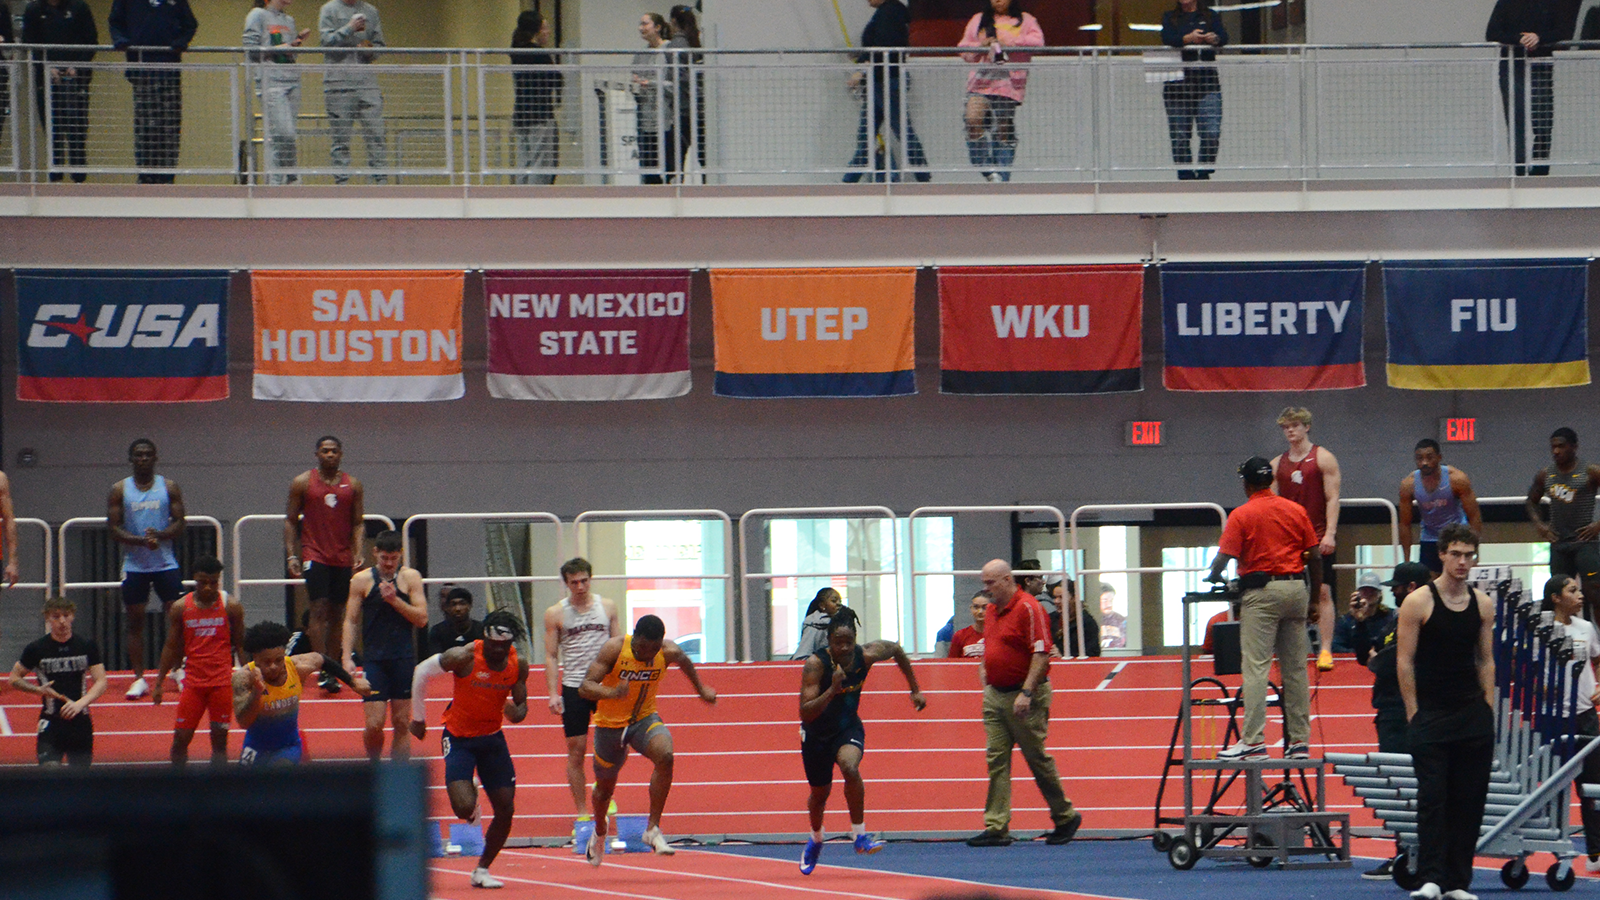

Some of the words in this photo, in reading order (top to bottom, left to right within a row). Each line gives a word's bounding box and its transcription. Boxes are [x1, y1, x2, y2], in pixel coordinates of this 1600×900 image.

[312, 289, 405, 321] SAM
[490, 293, 560, 318] NEW
[569, 291, 685, 318] MEXICO
[1176, 300, 1350, 336] LIBERTY
[1451, 298, 1516, 332] FIU
[761, 306, 869, 341] UTEP
[991, 304, 1090, 339] WKU
[262, 329, 458, 363] HOUSTON
[540, 330, 637, 355] STATE
[1132, 421, 1162, 444] EXIT
[1446, 418, 1476, 441] EXIT
[619, 669, 661, 681] UNCG
